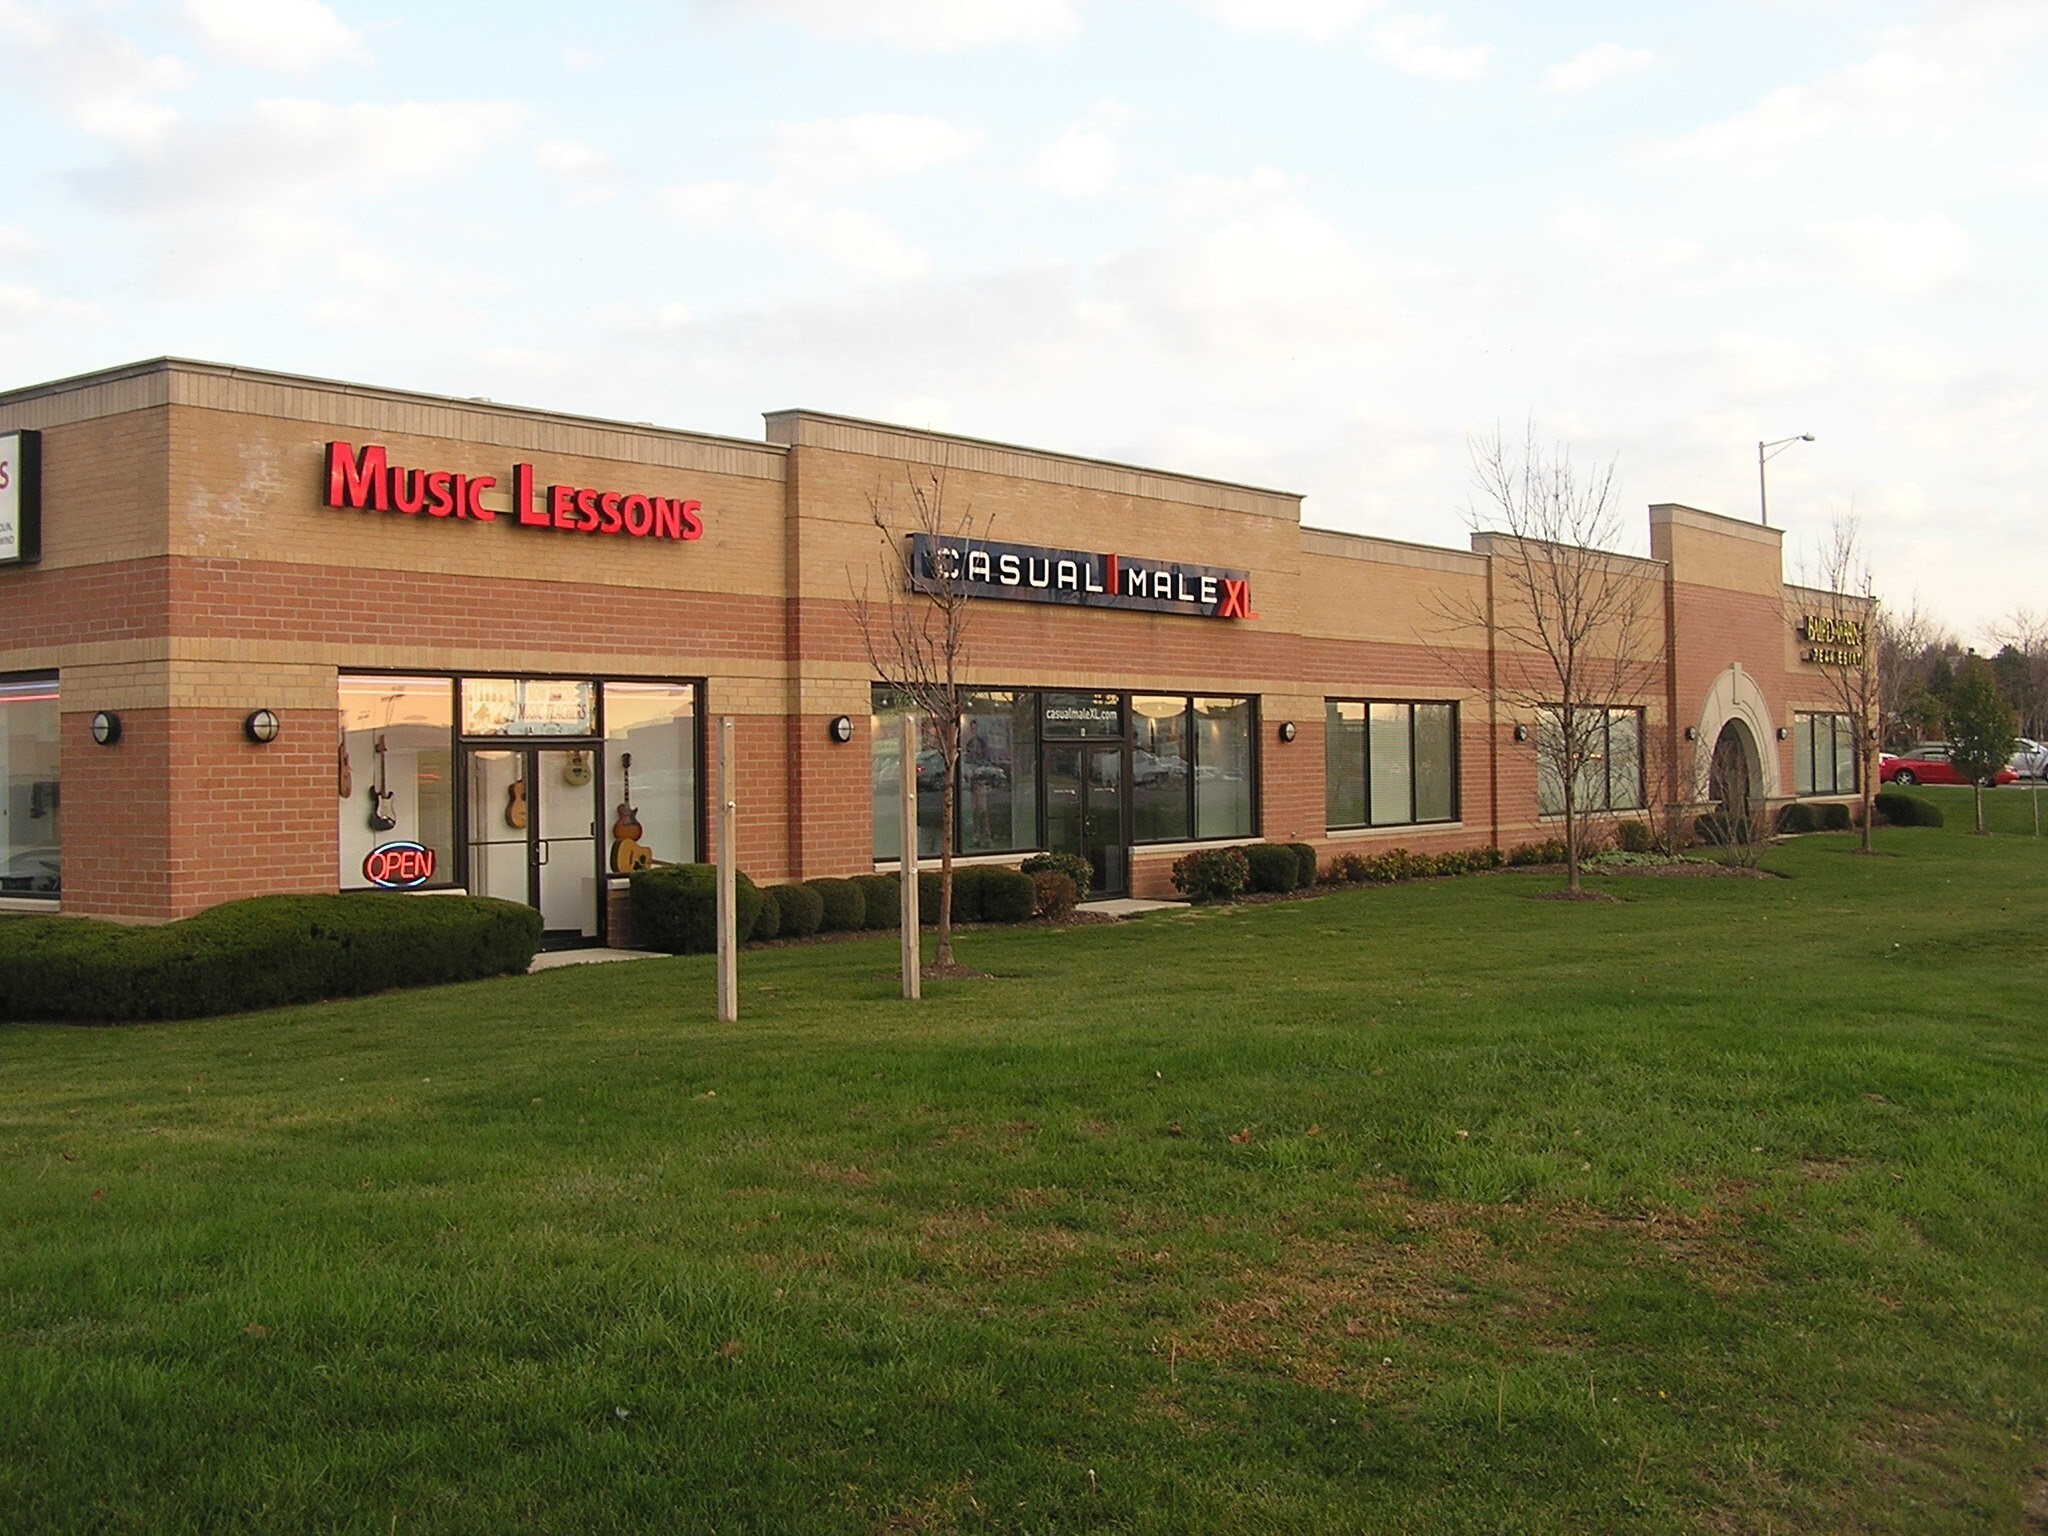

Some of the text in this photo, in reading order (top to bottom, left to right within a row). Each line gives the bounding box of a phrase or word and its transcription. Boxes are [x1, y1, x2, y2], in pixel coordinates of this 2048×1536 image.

[324, 441, 704, 541] MUSIC LESSONS
[936, 547, 1104, 593] CASUAL
[367, 850, 433, 881] OPEN
